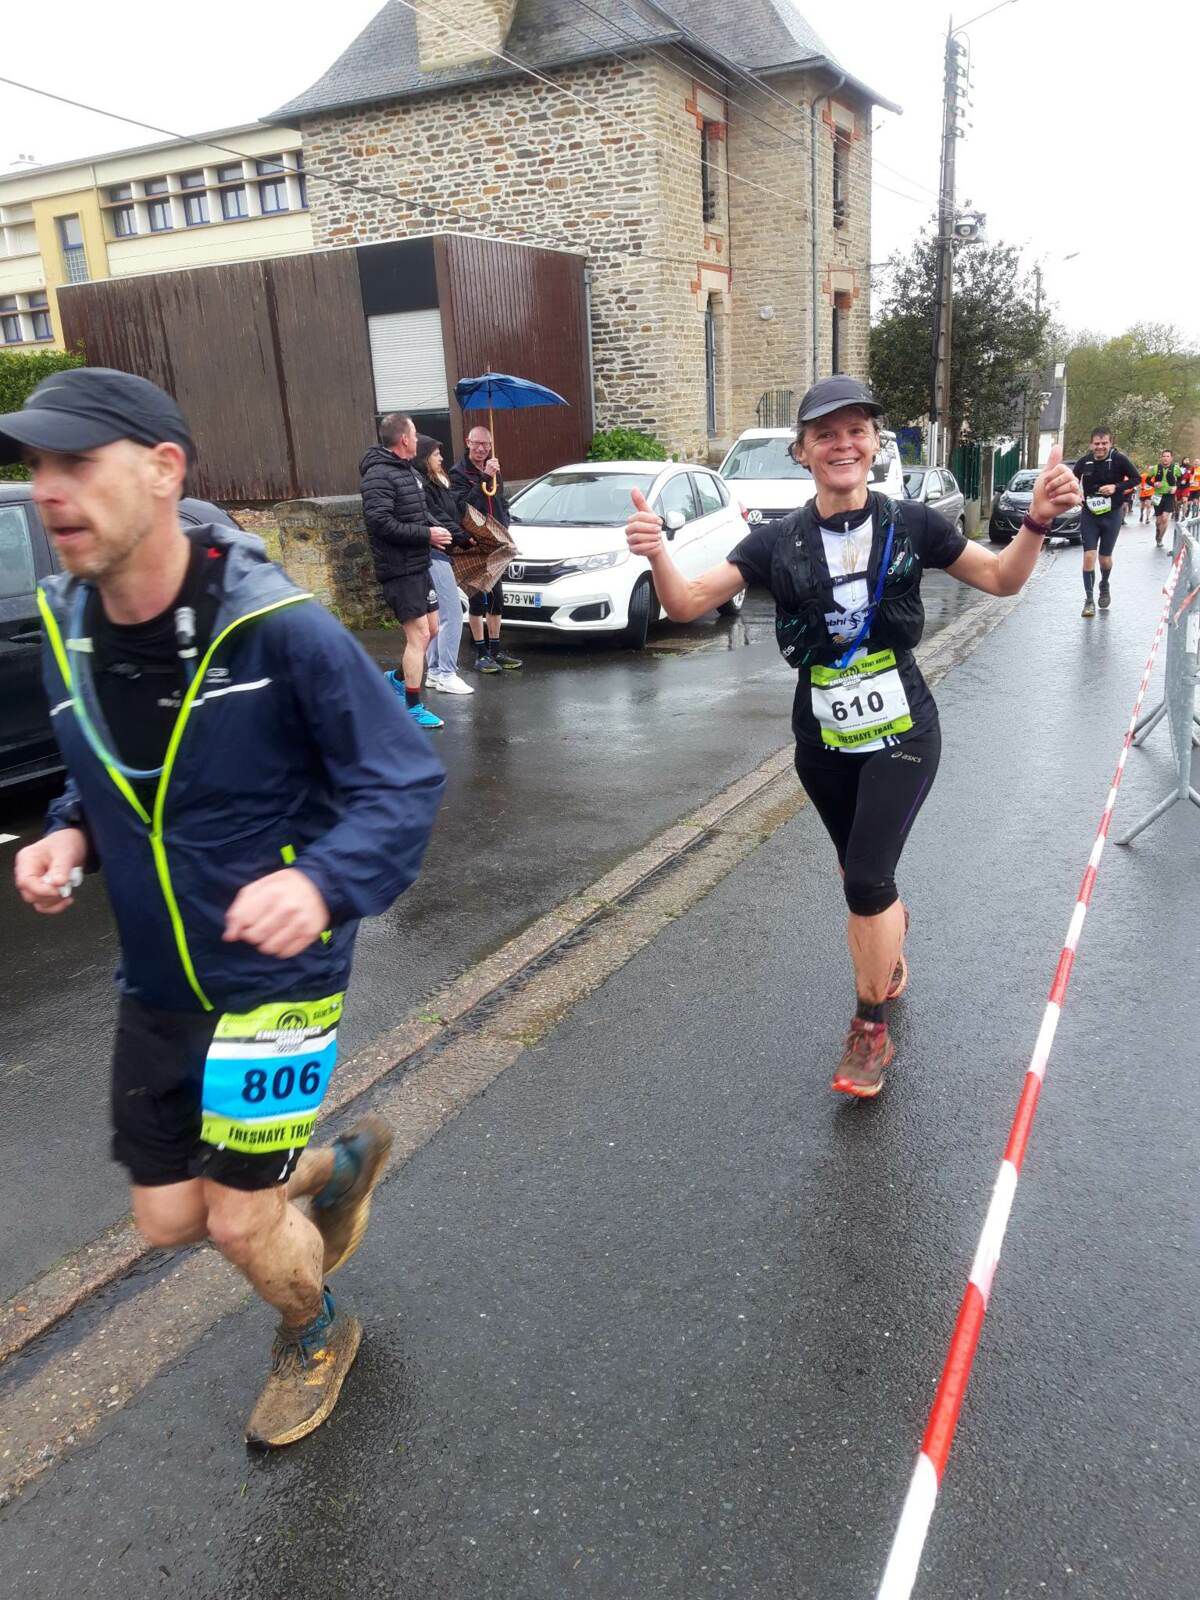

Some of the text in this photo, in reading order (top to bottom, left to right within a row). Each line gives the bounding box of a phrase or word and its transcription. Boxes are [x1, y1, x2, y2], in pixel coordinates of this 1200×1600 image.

[831, 691, 884, 721] 610
[874, 723, 894, 736] TRAIL
[241, 1061, 321, 1104] 806
[228, 1120, 315, 1145] FRESNAYE TRAI
